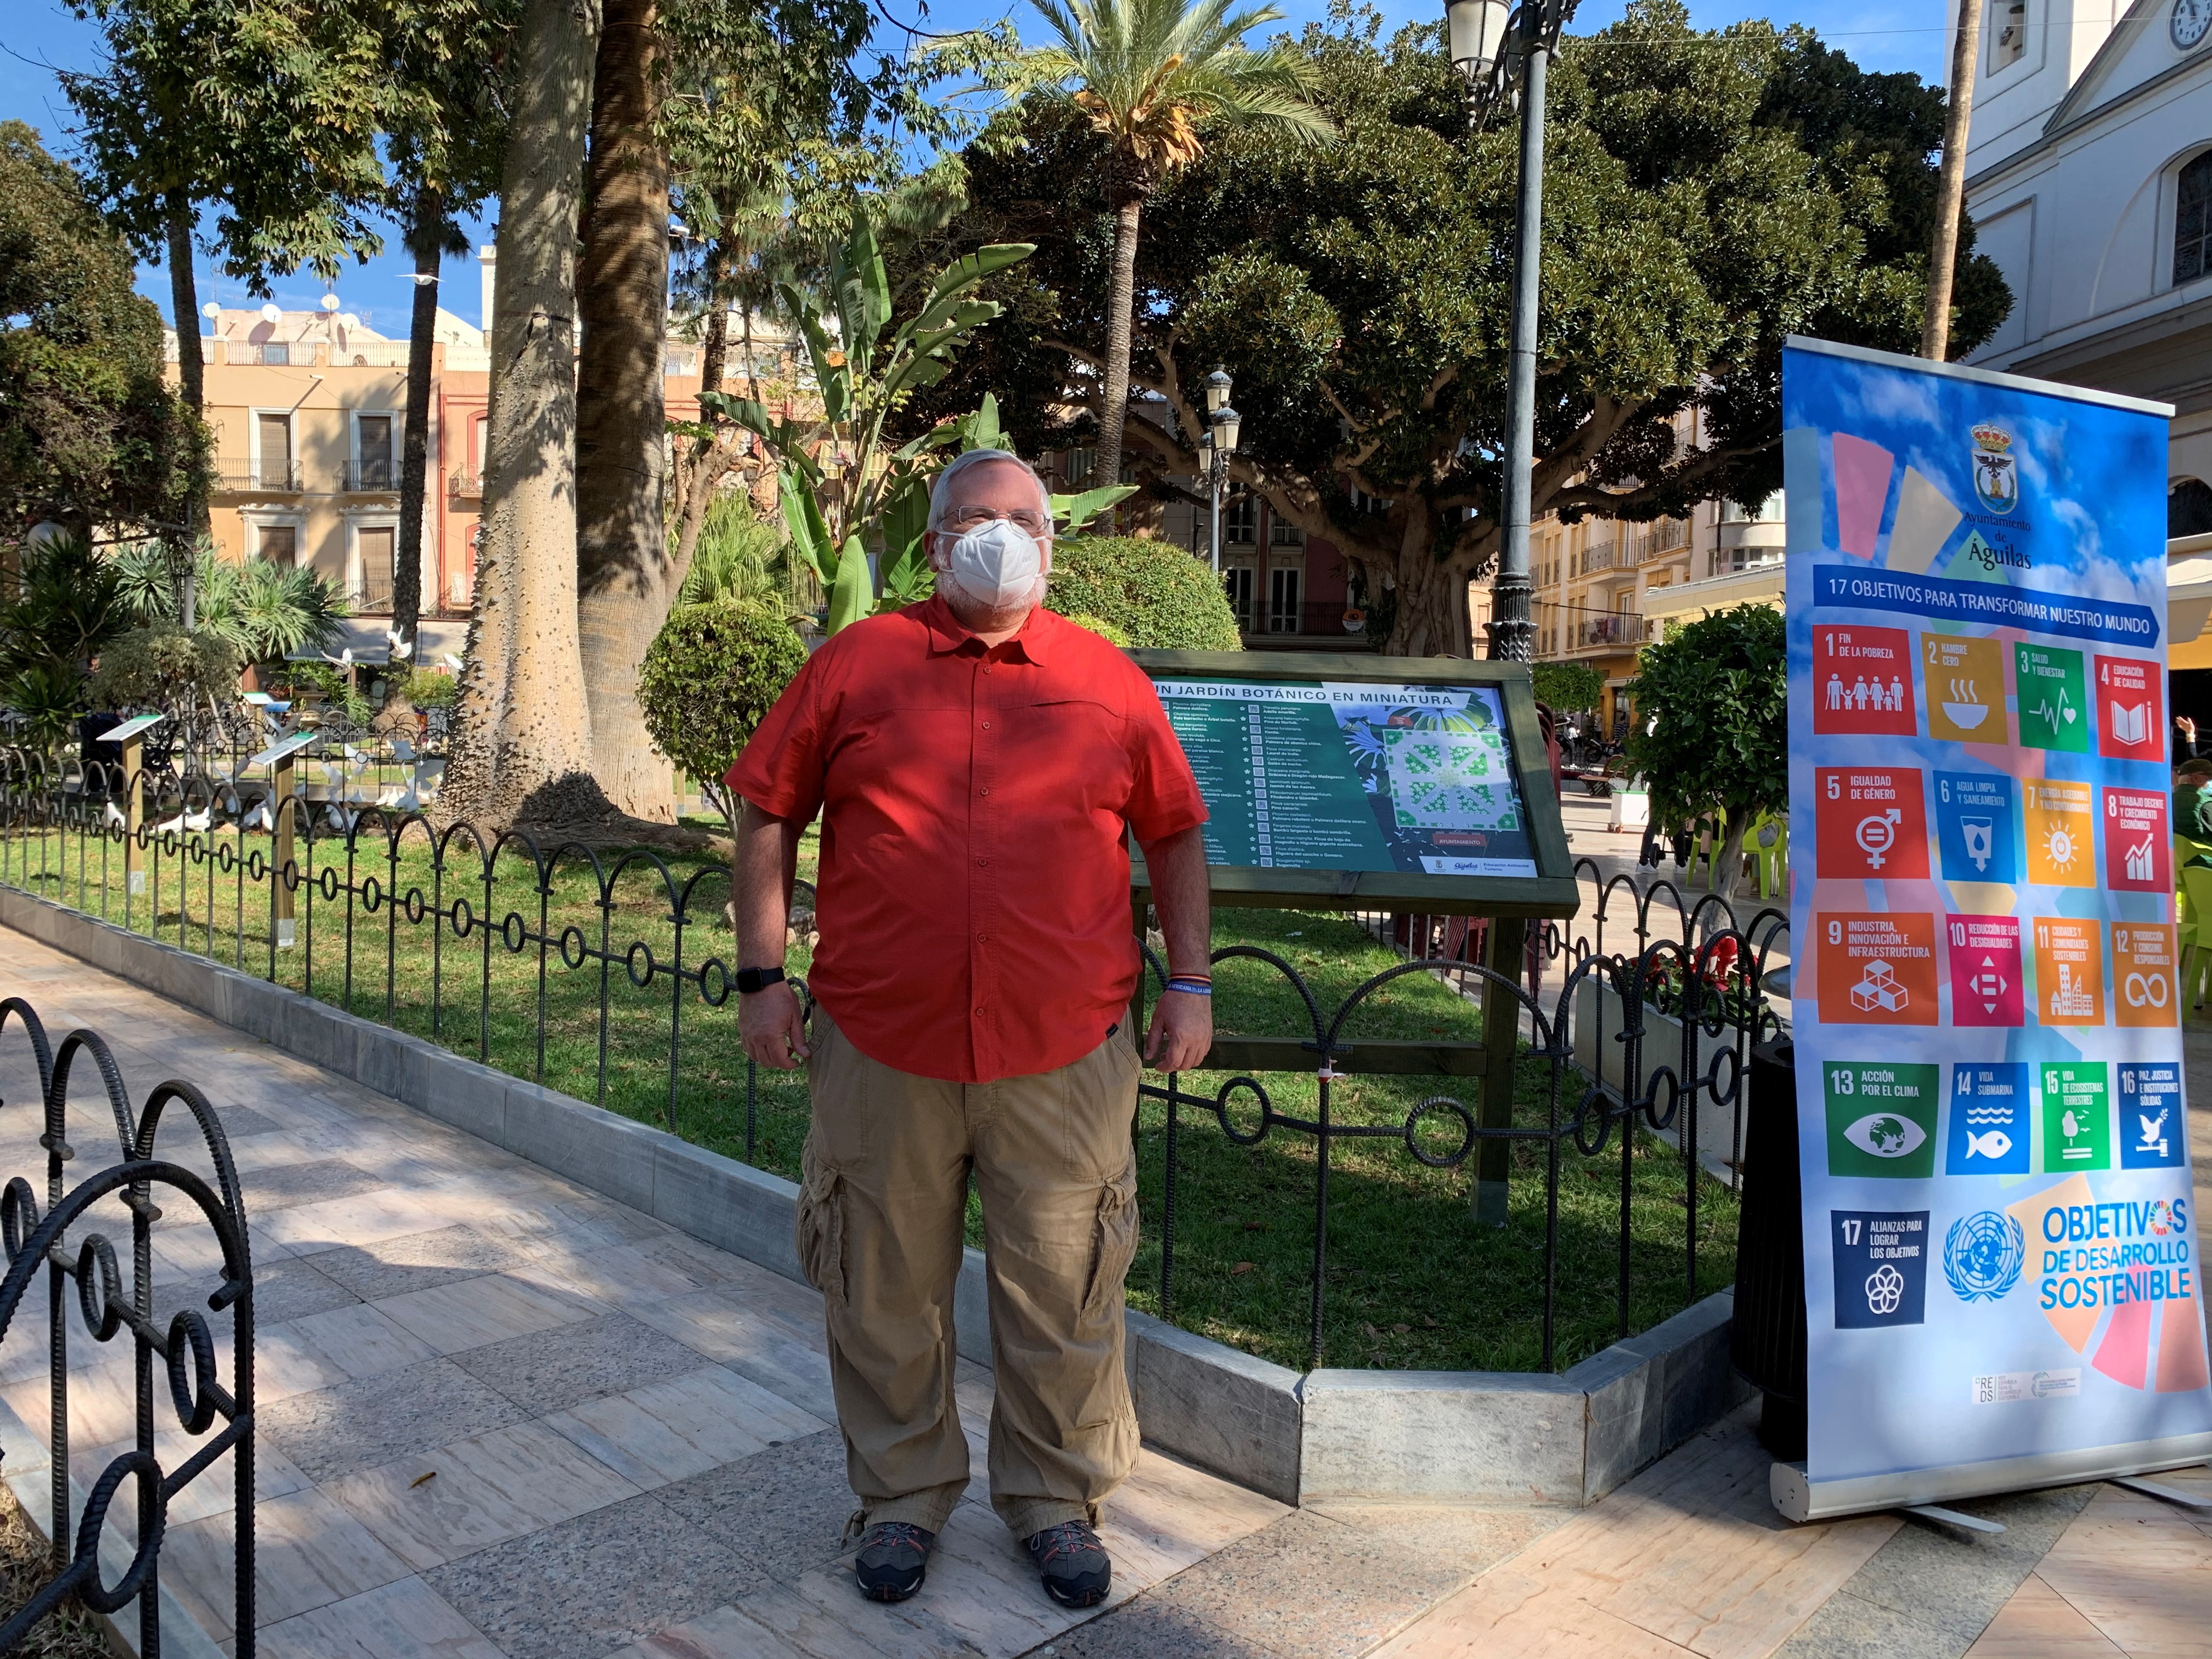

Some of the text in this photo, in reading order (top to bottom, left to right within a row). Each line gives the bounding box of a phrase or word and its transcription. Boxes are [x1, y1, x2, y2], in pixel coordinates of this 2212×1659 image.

[1965, 511, 2030, 532] Ayuntamiento
[1995, 531, 2007, 543] de
[1969, 538, 2032, 571] Águilas
[1829, 579, 2150, 631] 17 OBJETIVOS PARA TRANSFORMAR NUESTRO MUNDO
[1825, 633, 1834, 656] 1
[1839, 634, 1851, 644] FIN
[1839, 647, 1894, 659] DE LA POBREZA
[1928, 641, 1937, 664] 2
[1942, 644, 1968, 654] HAMBRE
[1943, 656, 1959, 667] CERO
[2021, 651, 2029, 673] 3
[2032, 653, 2049, 664] SALUD
[2032, 665, 2066, 679] Y BIENESTAR
[2101, 664, 2109, 685] 4
[2113, 665, 2144, 678] EDUCACIÓN
[2114, 676, 2145, 689] DE CALIDAD
[1178, 686, 1235, 697] JARDÍN
[1242, 688, 1327, 700] BOTÁNICO
[1333, 692, 1353, 702] EN
[1360, 692, 1453, 706] MINIATURA
[1827, 776, 1840, 799] 5
[1850, 776, 1891, 787] IGUALDAD
[1957, 781, 1996, 793] AGUA LIMPIA
[1851, 787, 1896, 800] DE GÉNERO
[1940, 780, 1950, 803] 6
[2029, 787, 2035, 808] 7
[1957, 793, 2005, 807] Y SANEAMIENTO
[2040, 799, 2044, 810] Y
[2045, 799, 2052, 810] NO
[2108, 795, 2117, 816] 8
[2119, 795, 2164, 809] TRABAJO DECENTE
[2120, 808, 2157, 820] Y CRECIMIENTO
[2120, 819, 2150, 831] ECONÓMICO
[1829, 921, 1842, 945] 9
[1848, 921, 1897, 932] INDUSTRIA,
[1968, 923, 2018, 935] REDUCCIÓN DE LAS
[2052, 925, 2081, 937] CIUDADES Y
[1848, 932, 1909, 945] INNOVACIÓN E
[1950, 923, 1966, 946] 10
[2038, 926, 2049, 948] 11
[2116, 930, 2128, 952] 12
[2133, 929, 2164, 941] PRODUCCIÓN
[1970, 937, 2012, 949] DESIGUALDADES
[2053, 938, 2088, 949] COMUNIDADES
[2134, 943, 2163, 953] Y CONSUMO
[1848, 947, 1929, 958] INFRAESTRUCTURA
[2053, 951, 2086, 961] SOSTENIBLES
[2134, 954, 2170, 965] RESPONSABLES
[1861, 1069, 1894, 1082] ACCIÓN
[1979, 1071, 1993, 1082] VIDA
[2062, 1070, 2074, 1081] VIDA
[2122, 1070, 2135, 1093] 16
[2152, 1070, 2173, 1080] JUSTICIA
[1831, 1070, 1854, 1094] 13
[1957, 1072, 1971, 1095] 14
[2045, 1071, 2058, 1094] 15
[2063, 1082, 2103, 1093] DE ECOSISTEMAS
[2140, 1082, 2178, 1093] E INSTITUCIONES
[1861, 1085, 1919, 1097] POR EL CLIMA
[1978, 1084, 2013, 1096] SUBMARINA
[2063, 1095, 2093, 1105] TERRESTRES
[2140, 1094, 2162, 1105] SÓLIDAS
[1870, 1220, 1922, 1233] ALIANZAS PARA
[2043, 1199, 2187, 1243] OBJETIVOS
[1842, 1220, 1861, 1245] 17
[1870, 1234, 1899, 1245] LOGRAR
[1870, 1245, 1919, 1259] LOS OBJETIVOS
[2043, 1240, 2189, 1273] DE DESARROLLO
[2040, 1268, 2191, 1310] SOSTENIBLE
